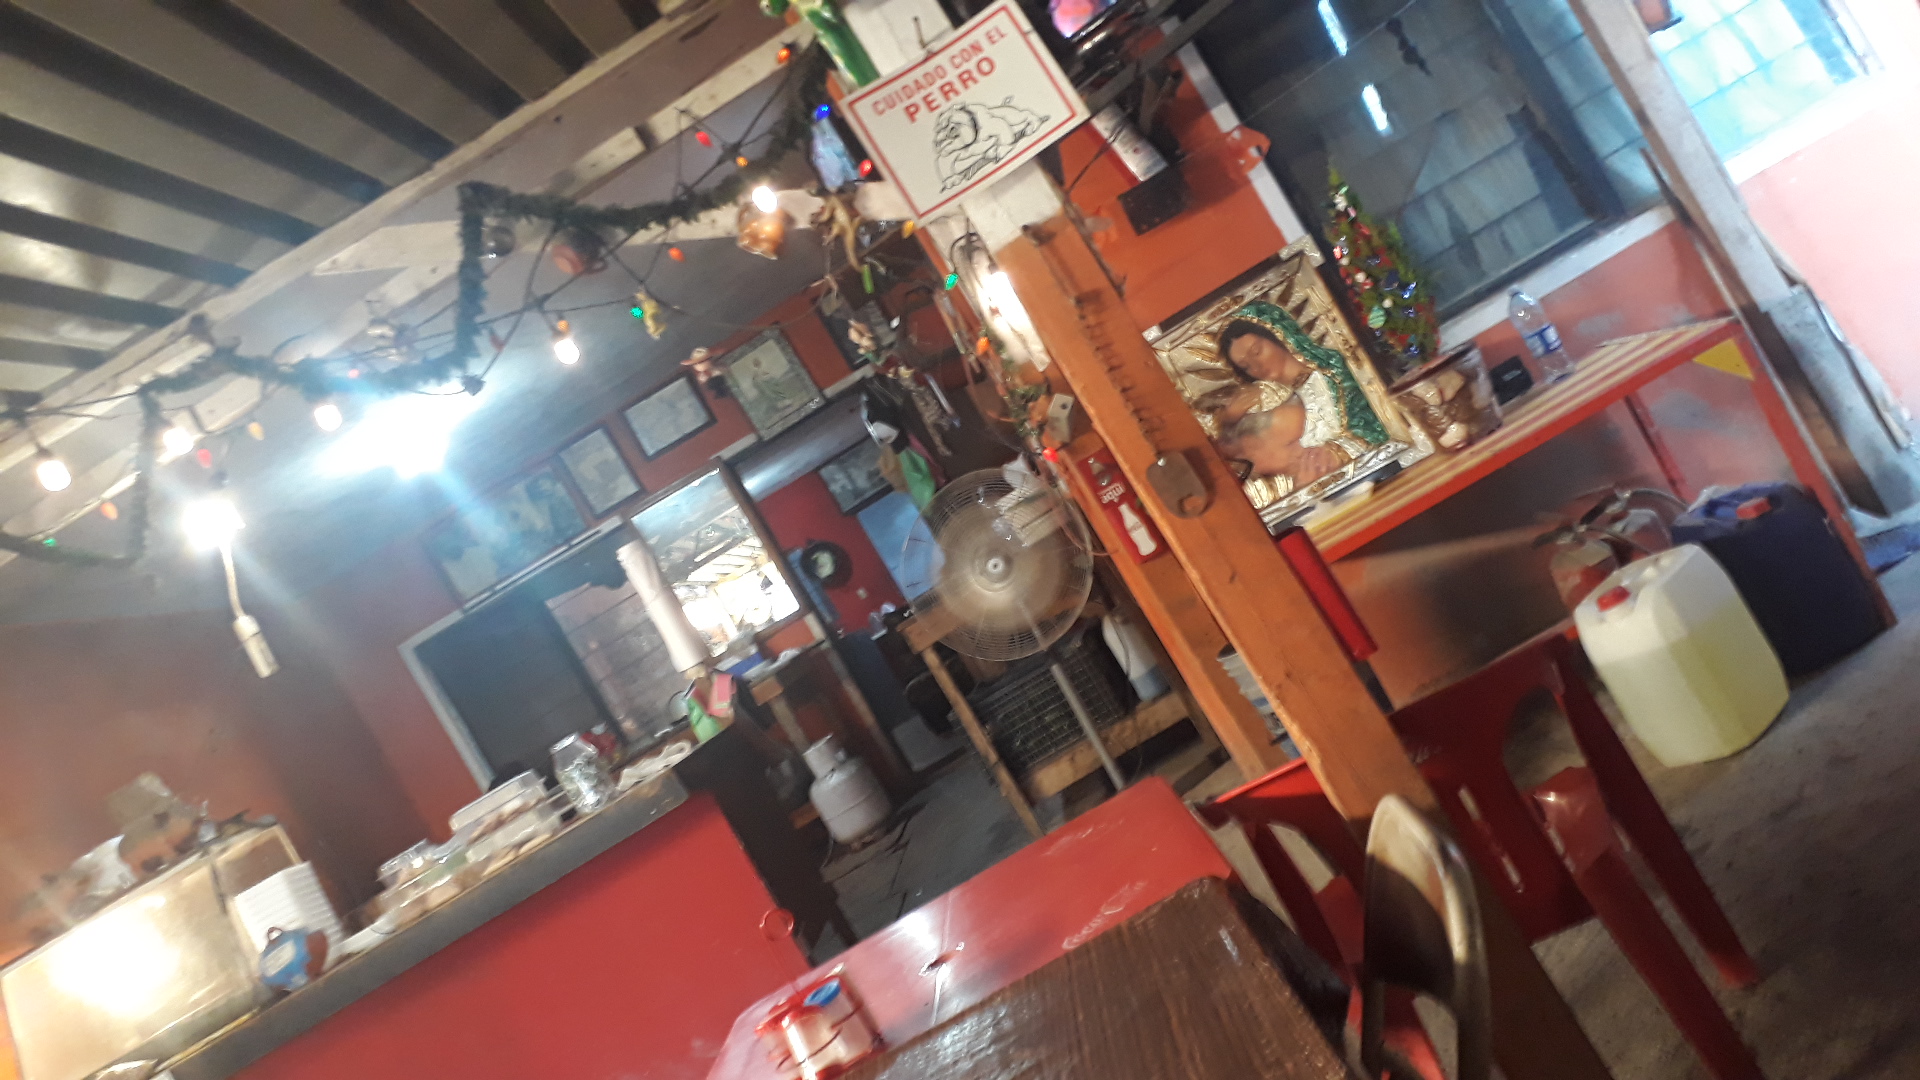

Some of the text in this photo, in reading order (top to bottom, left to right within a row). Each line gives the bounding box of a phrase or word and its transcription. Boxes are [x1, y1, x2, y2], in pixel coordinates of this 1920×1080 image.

[872, 26, 1008, 116] CUIDADO CON EL
[904, 57, 996, 123] PERRO
[1061, 880, 1149, 950] Coca-C
